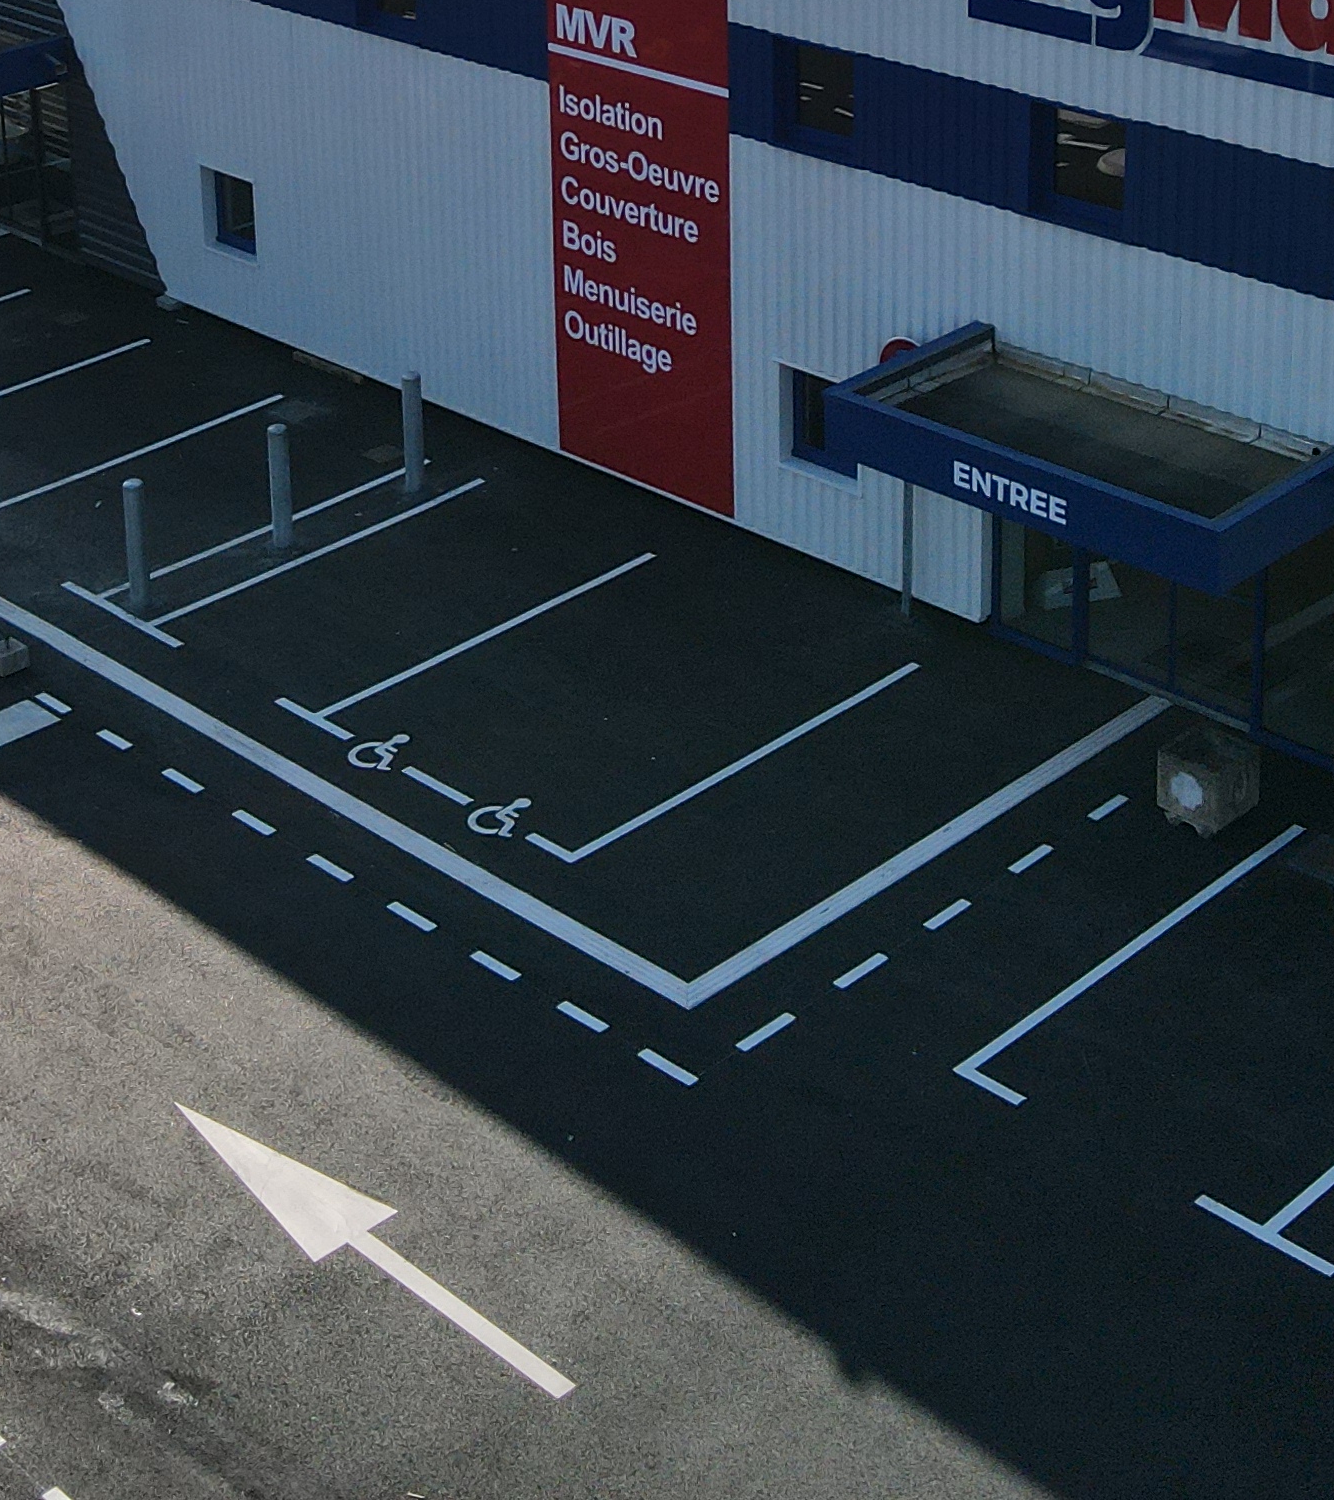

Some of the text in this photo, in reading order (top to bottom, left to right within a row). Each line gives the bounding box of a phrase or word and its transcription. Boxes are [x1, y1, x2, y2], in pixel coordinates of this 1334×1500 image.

[555, 3, 638, 59] MVR
[559, 85, 663, 140] Isolation
[560, 132, 721, 204] Gros-Oeuvre
[561, 176, 700, 244] Couverture
[562, 220, 618, 264] Bois
[563, 264, 698, 336] Menuiserie
[564, 310, 673, 375] Outillage
[953, 460, 1068, 526] ENTREE
